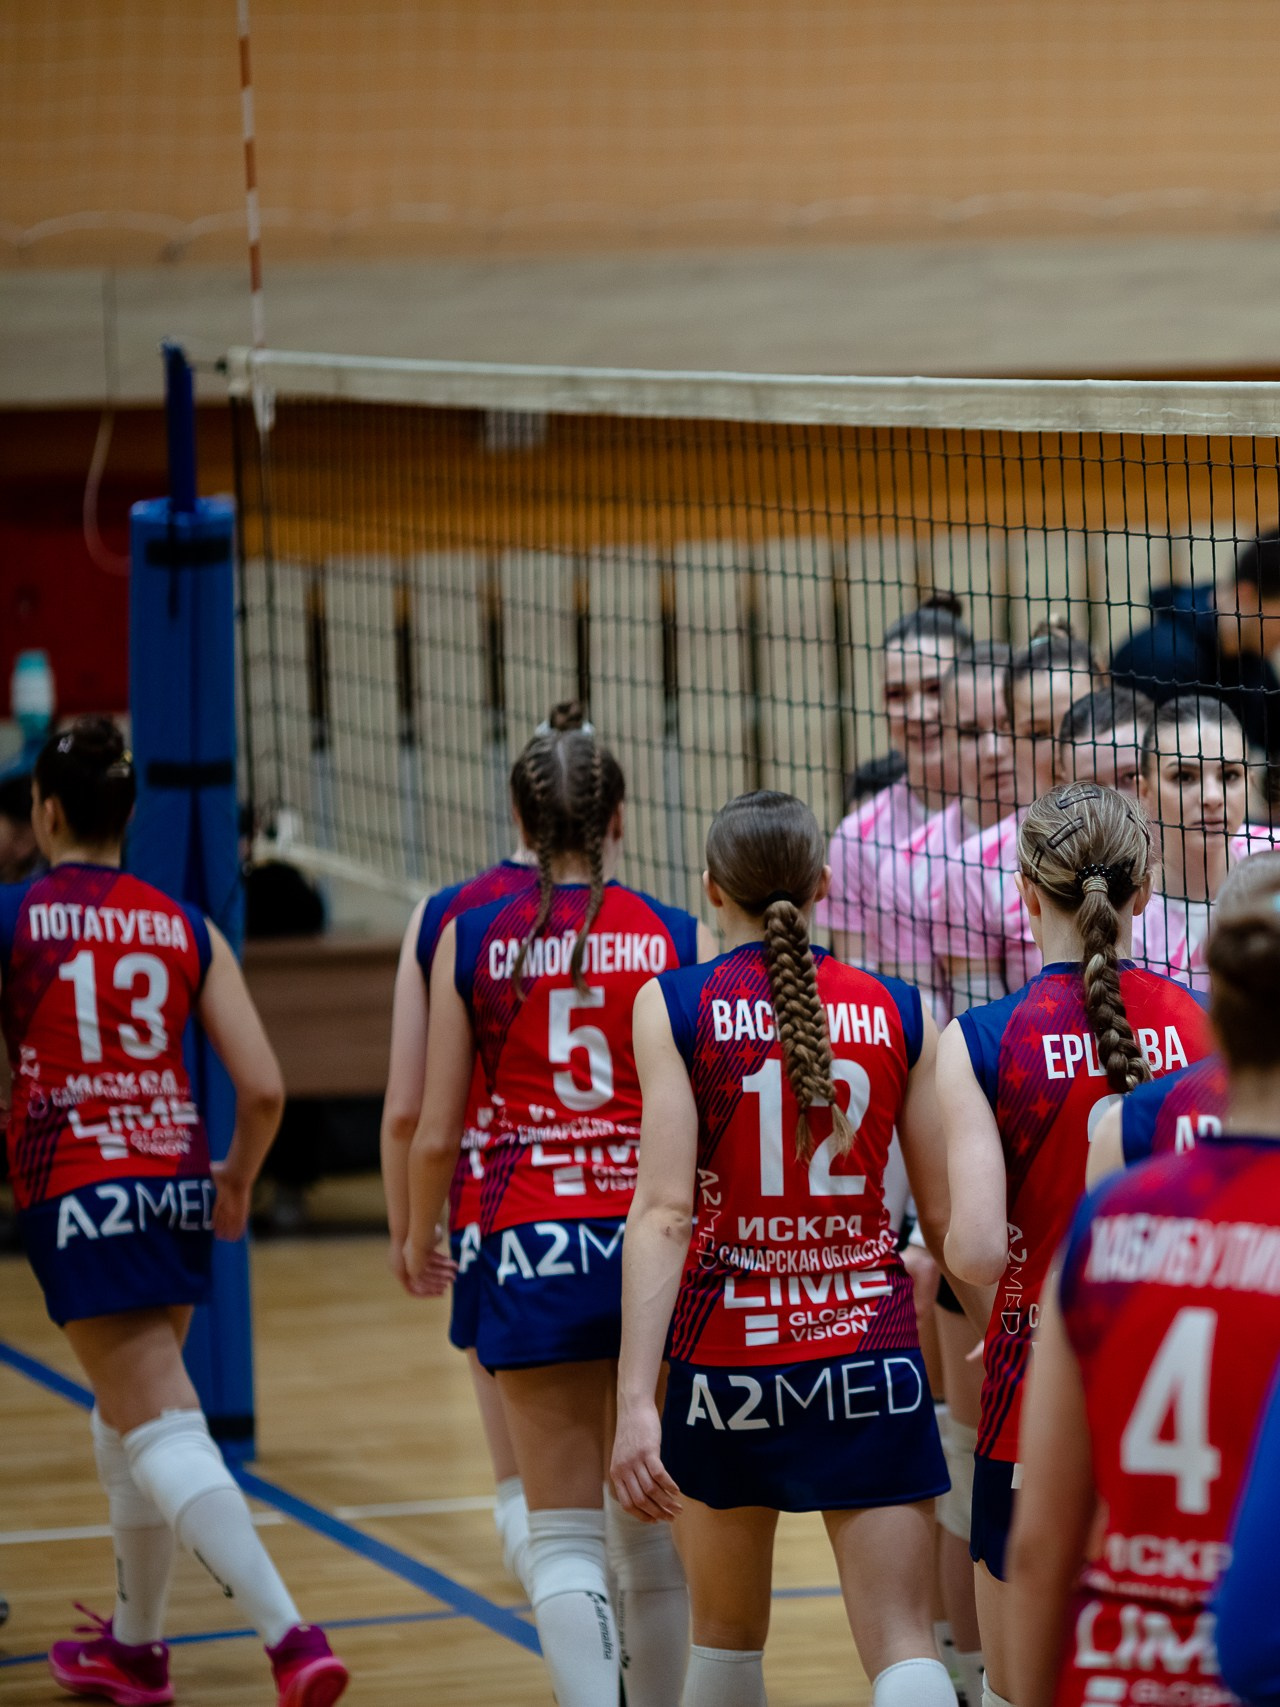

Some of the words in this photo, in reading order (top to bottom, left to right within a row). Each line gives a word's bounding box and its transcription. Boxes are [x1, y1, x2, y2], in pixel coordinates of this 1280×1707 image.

[29, 903, 188, 952] ПОТАТУЕВА
[488, 929, 667, 981] САМОЙЛЕНКО
[59, 950, 170, 1064] 13
[711, 998, 892, 1048] ВАСИНА
[548, 986, 614, 1112] 5
[742, 1058, 872, 1197] 12
[737, 1214, 863, 1242] ИСКРА
[718, 1245, 820, 1274] САМАРСКАЯ
[724, 1268, 893, 1309] LIME
[788, 1303, 878, 1327] GLOBAL
[790, 1318, 869, 1342] VISION
[686, 1356, 922, 1431] A2MED
[1120, 1306, 1220, 1515] 4
